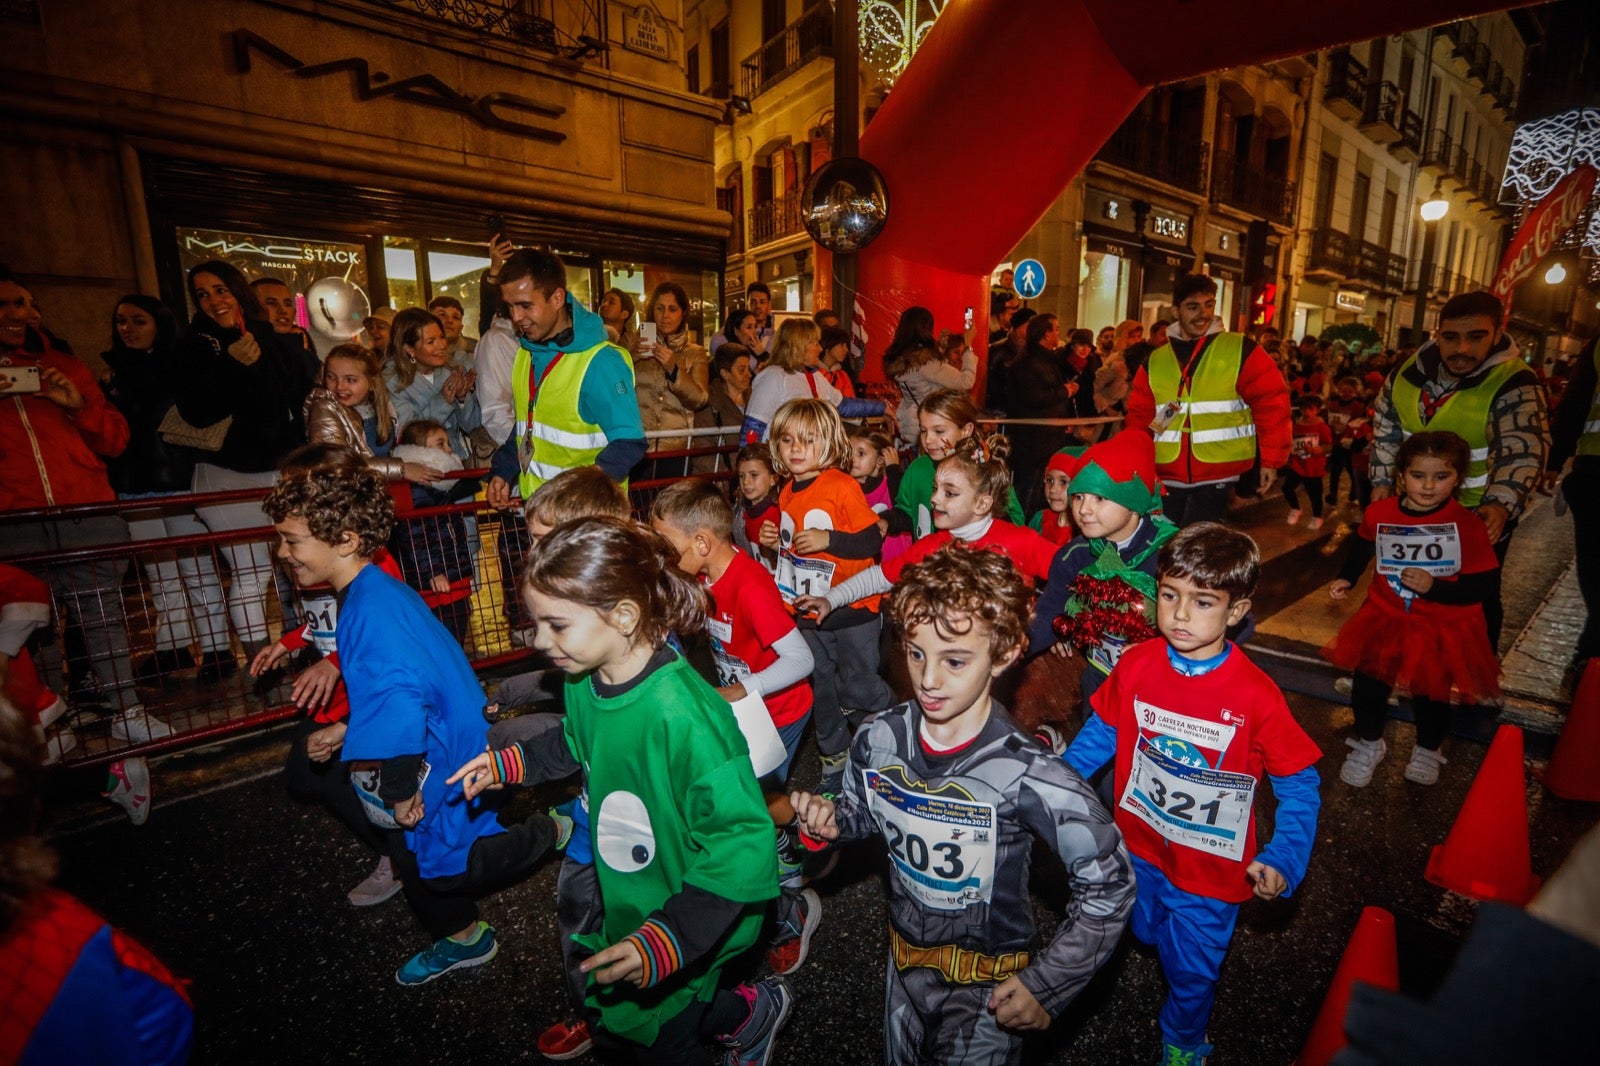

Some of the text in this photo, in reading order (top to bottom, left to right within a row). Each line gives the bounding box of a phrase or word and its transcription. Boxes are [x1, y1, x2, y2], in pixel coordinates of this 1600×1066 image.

[1154, 215, 1186, 239] TOUS
[261, 260, 297, 270] MASCARA
[304, 249, 359, 265] STACK
[1391, 543, 1443, 560] 370
[305, 610, 333, 630] 91
[1143, 708, 1220, 737] 30 CARRERA NOCTURNA
[954, 804, 978, 813] diciembre
[1148, 777, 1221, 826] 321
[906, 807, 991, 827] #NocturnaGranada2022
[886, 820, 965, 880] 203
